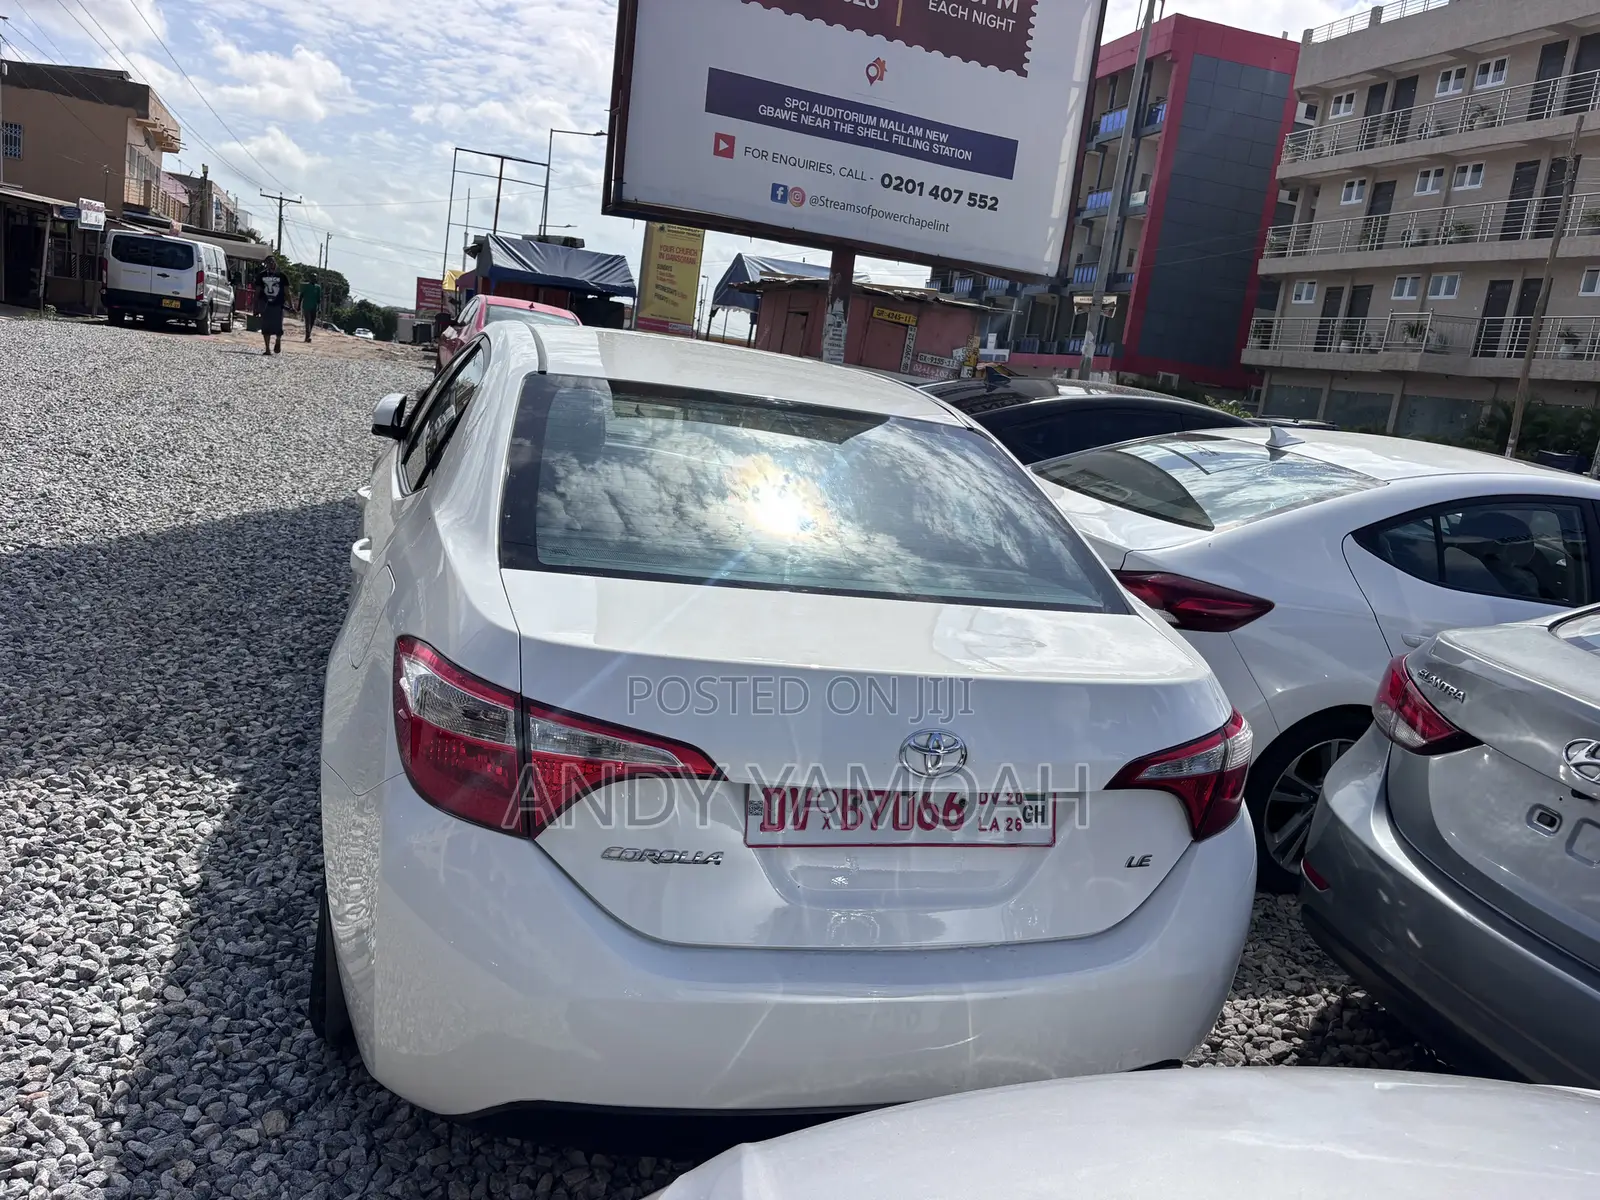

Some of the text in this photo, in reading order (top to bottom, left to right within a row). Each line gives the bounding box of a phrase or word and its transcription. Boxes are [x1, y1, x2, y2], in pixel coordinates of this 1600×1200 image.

[928, 0, 969, 20] EACH
[972, 10, 1016, 33] NIGHT
[758, 104, 972, 161] GBAWE NEAR THE SHELL FILLING STATION
[784, 97, 949, 143] SPCI AUDITORIUM MALLAM NEW
[744, 146, 769, 161] FOR
[771, 152, 836, 176] ENQUIRIES,
[839, 166, 867, 182] CALL
[880, 173, 925, 197] 0201
[928, 185, 963, 204] 407
[967, 192, 999, 212] 552
[809, 195, 950, 233] @Streamsofpowerchapelint
[658, 251, 665, 260] IN
[660, 244, 698, 256] YOUR CHURCH
[1417, 669, 1466, 704] ELANTRA
[978, 817, 1023, 832] LA 26
[1022, 804, 1046, 824] GH
[601, 846, 724, 865] COROLLA
[1124, 854, 1153, 868] LE
